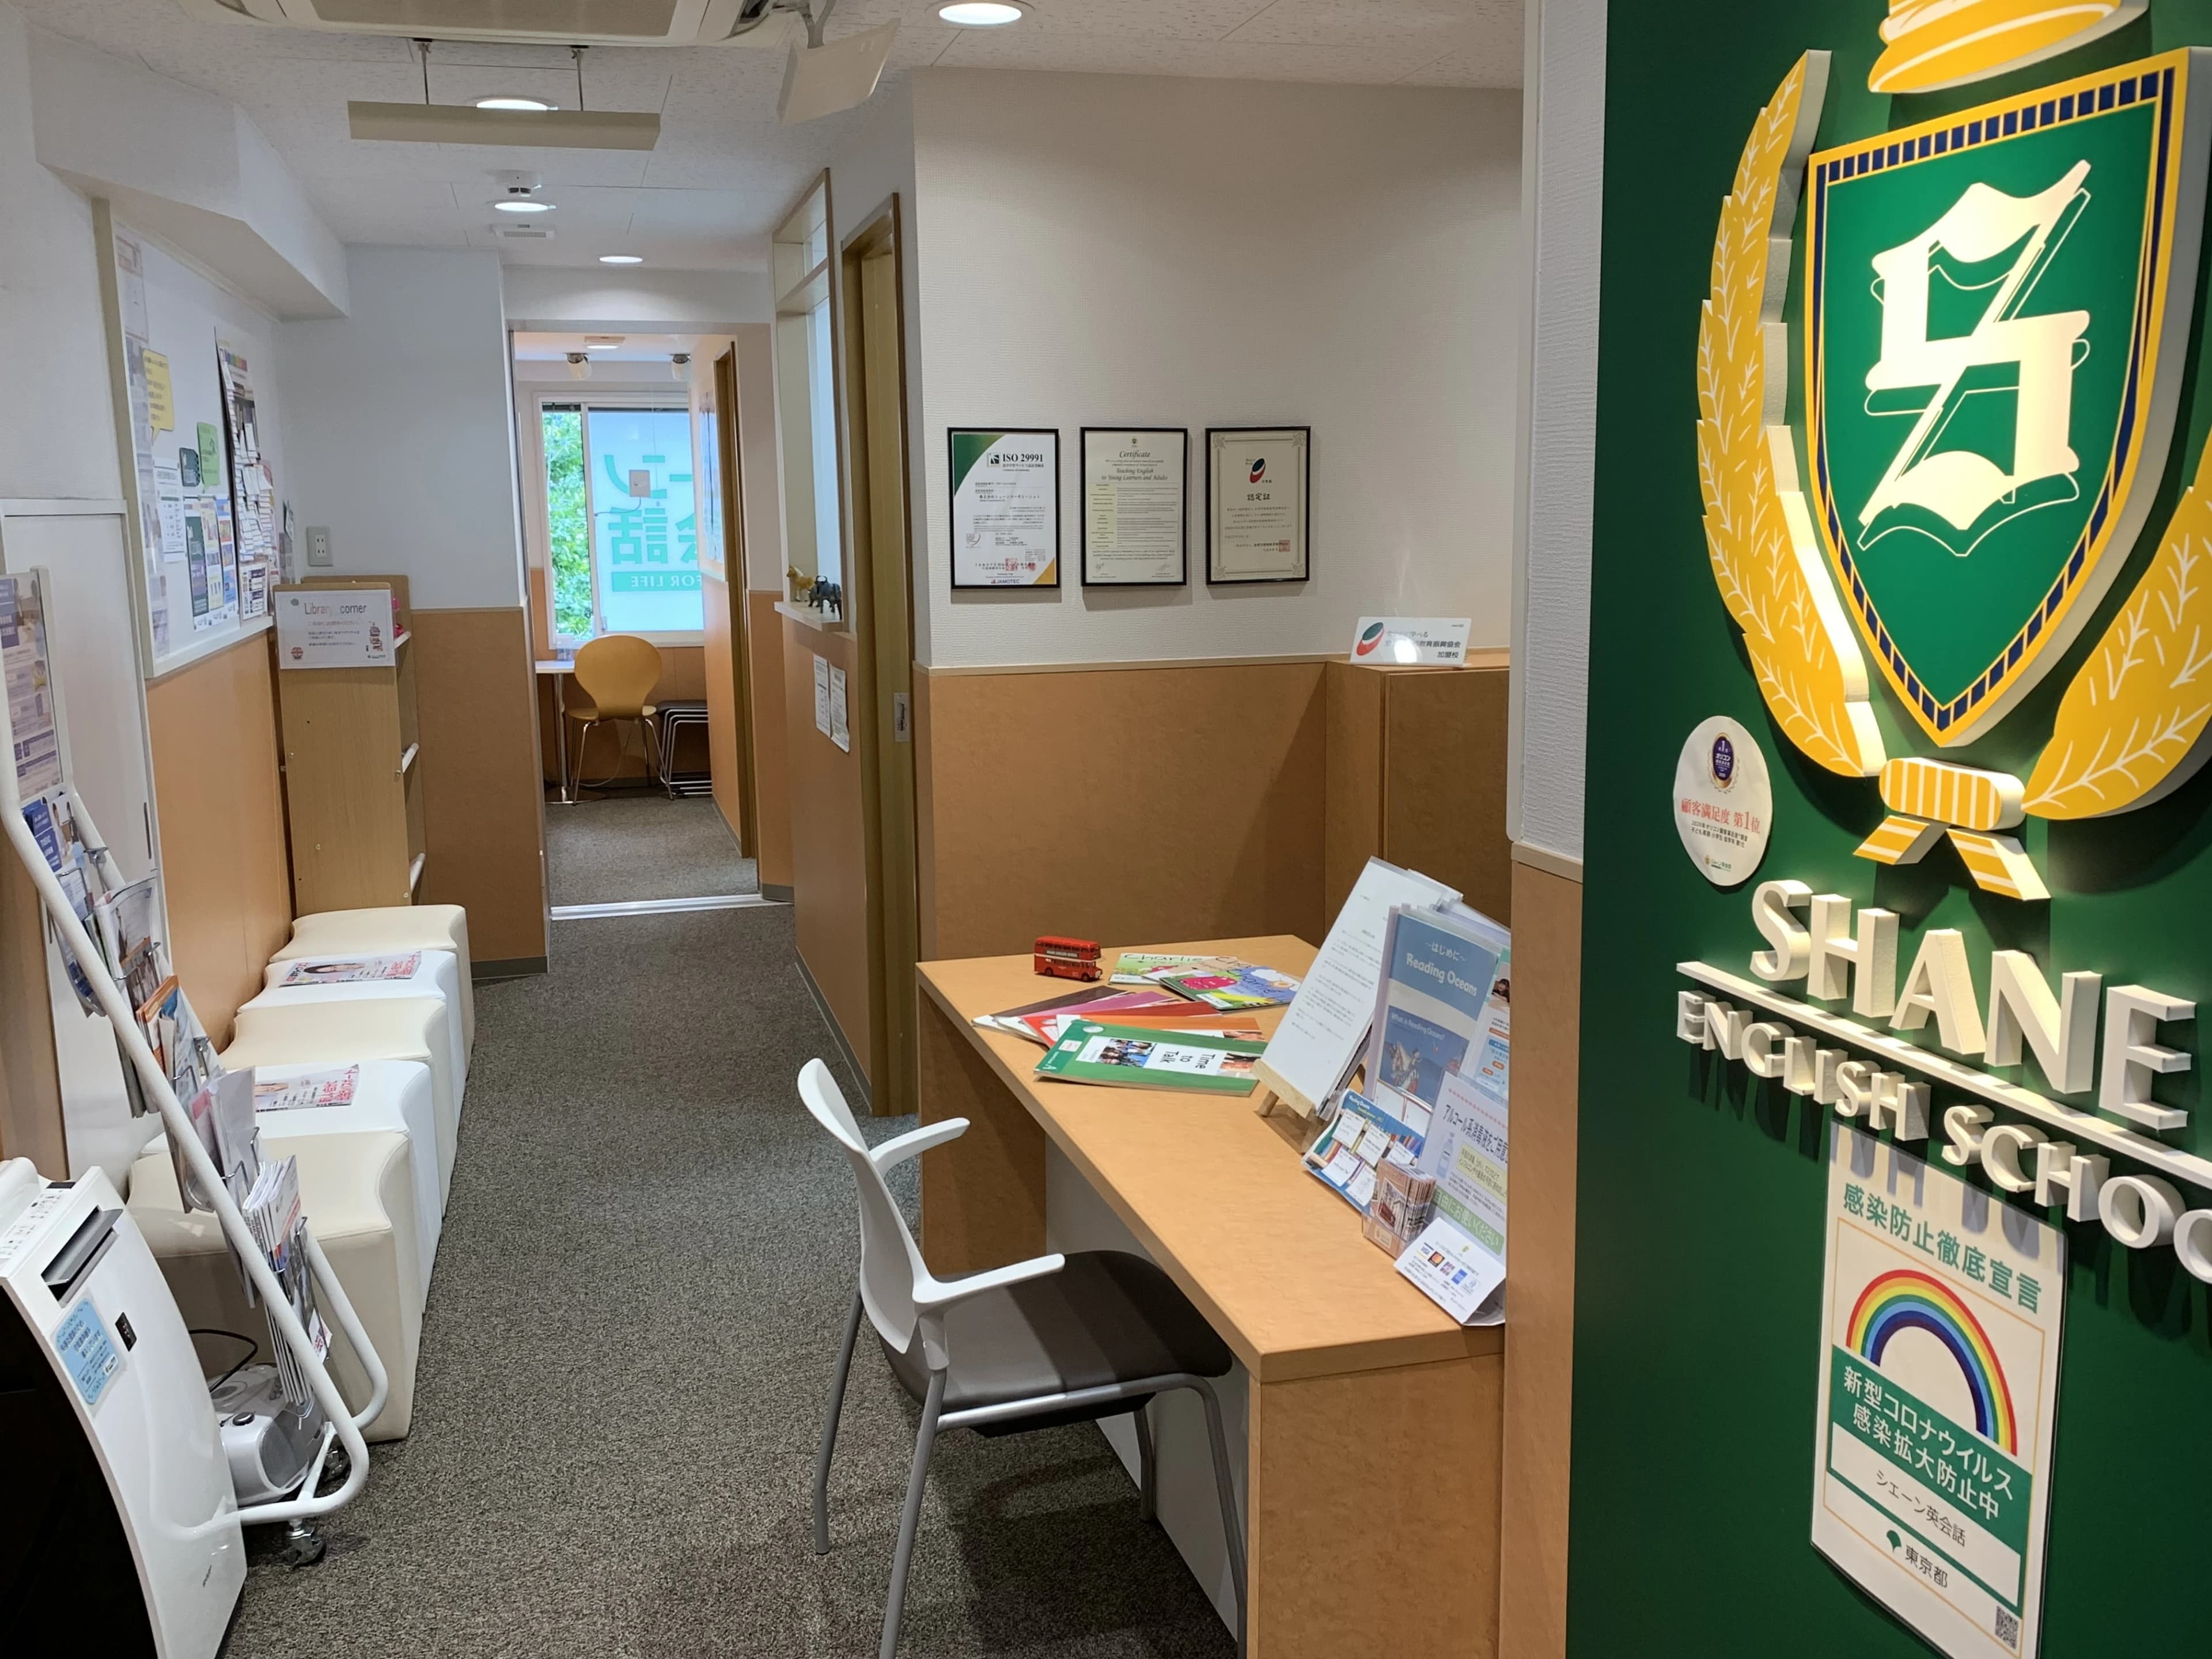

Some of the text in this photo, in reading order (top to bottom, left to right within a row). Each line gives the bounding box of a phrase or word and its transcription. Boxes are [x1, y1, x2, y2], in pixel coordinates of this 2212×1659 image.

[1002, 453, 1044, 462] ISO 29991
[1119, 450, 1151, 459] Certificate
[1247, 493, 1271, 502] 認定証
[340, 605, 367, 615] corner
[1681, 797, 1761, 834] 顧客満足度 第1位
[1406, 952, 1478, 997] Reading Oceans
[1750, 879, 2197, 1130] SHANE
[1160, 1051, 1180, 1063] Talk
[1195, 1054, 1216, 1069] Time
[1676, 990, 1930, 1141] ENGLISH
[1843, 1182, 2041, 1315] 感染防止徹底宣言
[1843, 1365, 2014, 1501] 新型コロナウイルス
[1853, 1403, 1999, 1520] 感染拡大防止中
[1876, 1469, 1965, 1547] シェーン英会話
[1905, 1544, 1948, 1589] 東京都
